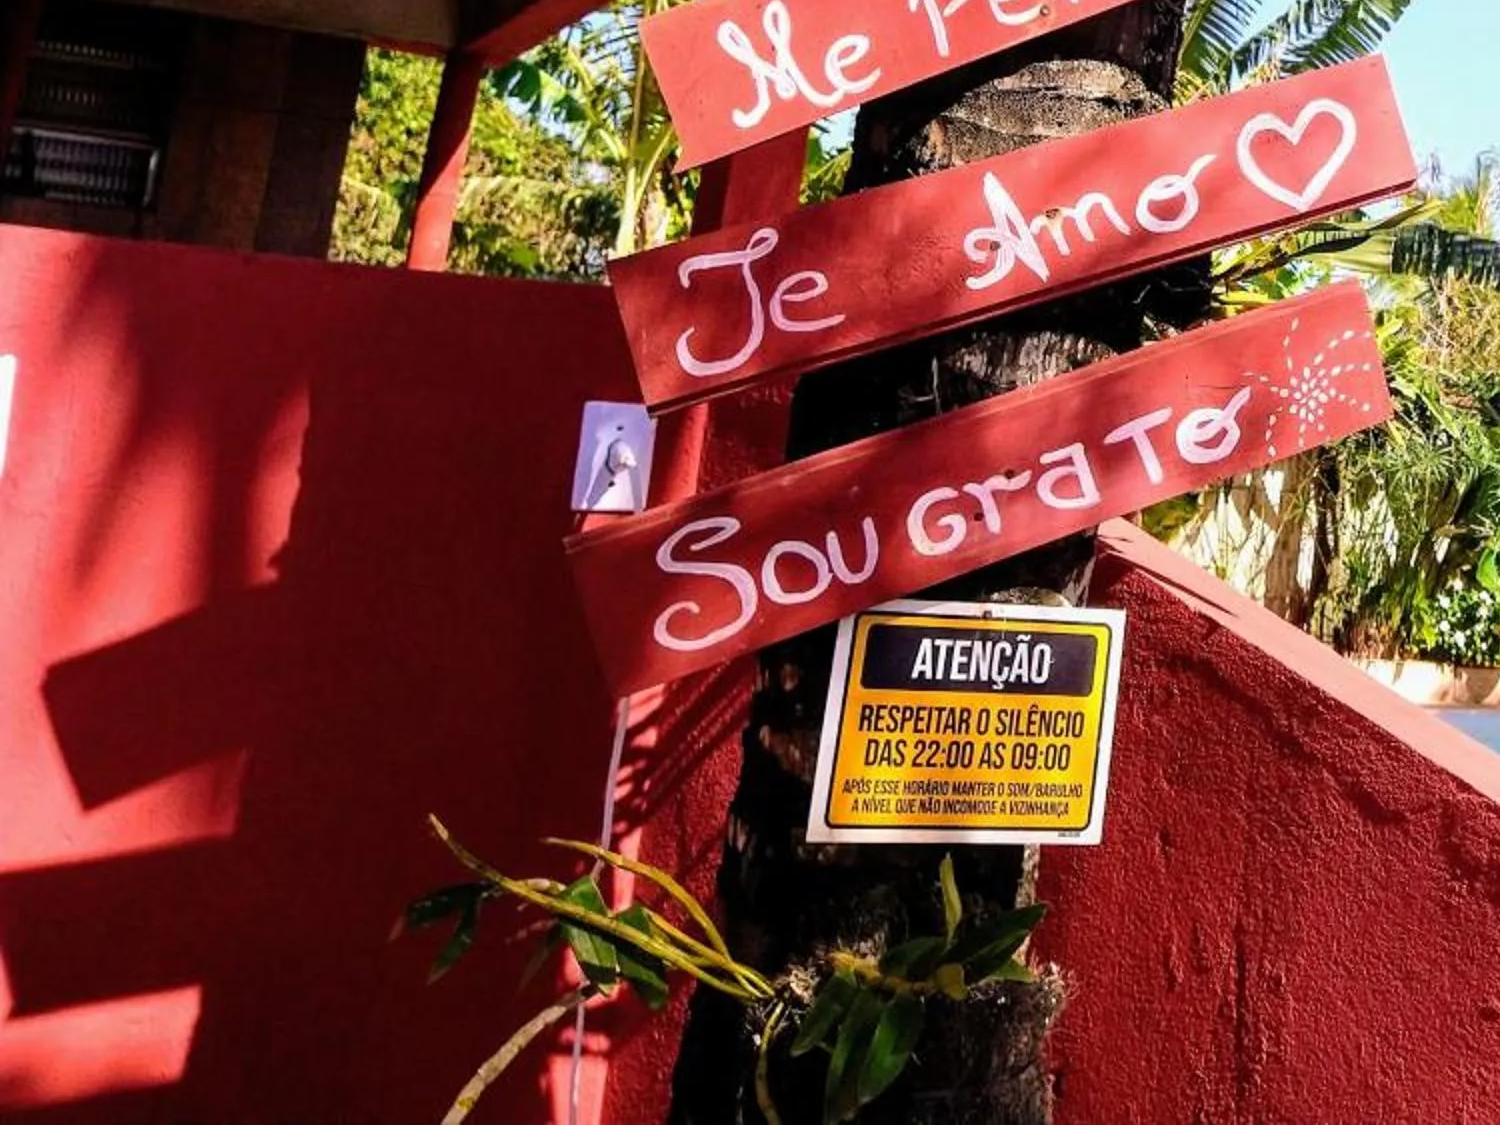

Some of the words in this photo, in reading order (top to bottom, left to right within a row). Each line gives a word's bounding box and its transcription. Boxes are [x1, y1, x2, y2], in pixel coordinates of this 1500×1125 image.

[716, 0, 882, 130] Me
[962, 154, 1217, 290] Amo
[652, 515, 880, 652] Sou
[911, 634, 1050, 690] ATENÇÃO
[859, 704, 971, 734] RESPEITAR
[976, 708, 991, 736] O
[995, 704, 1085, 738] SILÊNCIO
[864, 739, 907, 766] DAS
[912, 740, 975, 768] 22:00
[978, 742, 1007, 769] AS
[1011, 743, 1071, 770] 09:00
[842, 777, 872, 794] APÓS
[873, 779, 900, 795] ESSE
[903, 778, 949, 796] HORÁRIO
[951, 780, 995, 796] MANTER
[998, 782, 1005, 797] O
[1007, 782, 1083, 798] SOM/BARULHO
[851, 798, 859, 812] A
[862, 796, 892, 814] NÍVEL
[895, 799, 917, 813] QUE
[919, 797, 940, 814] NÃO
[1000, 800, 1006, 814] A
[1009, 801, 1069, 818] VIZINHANÇA
